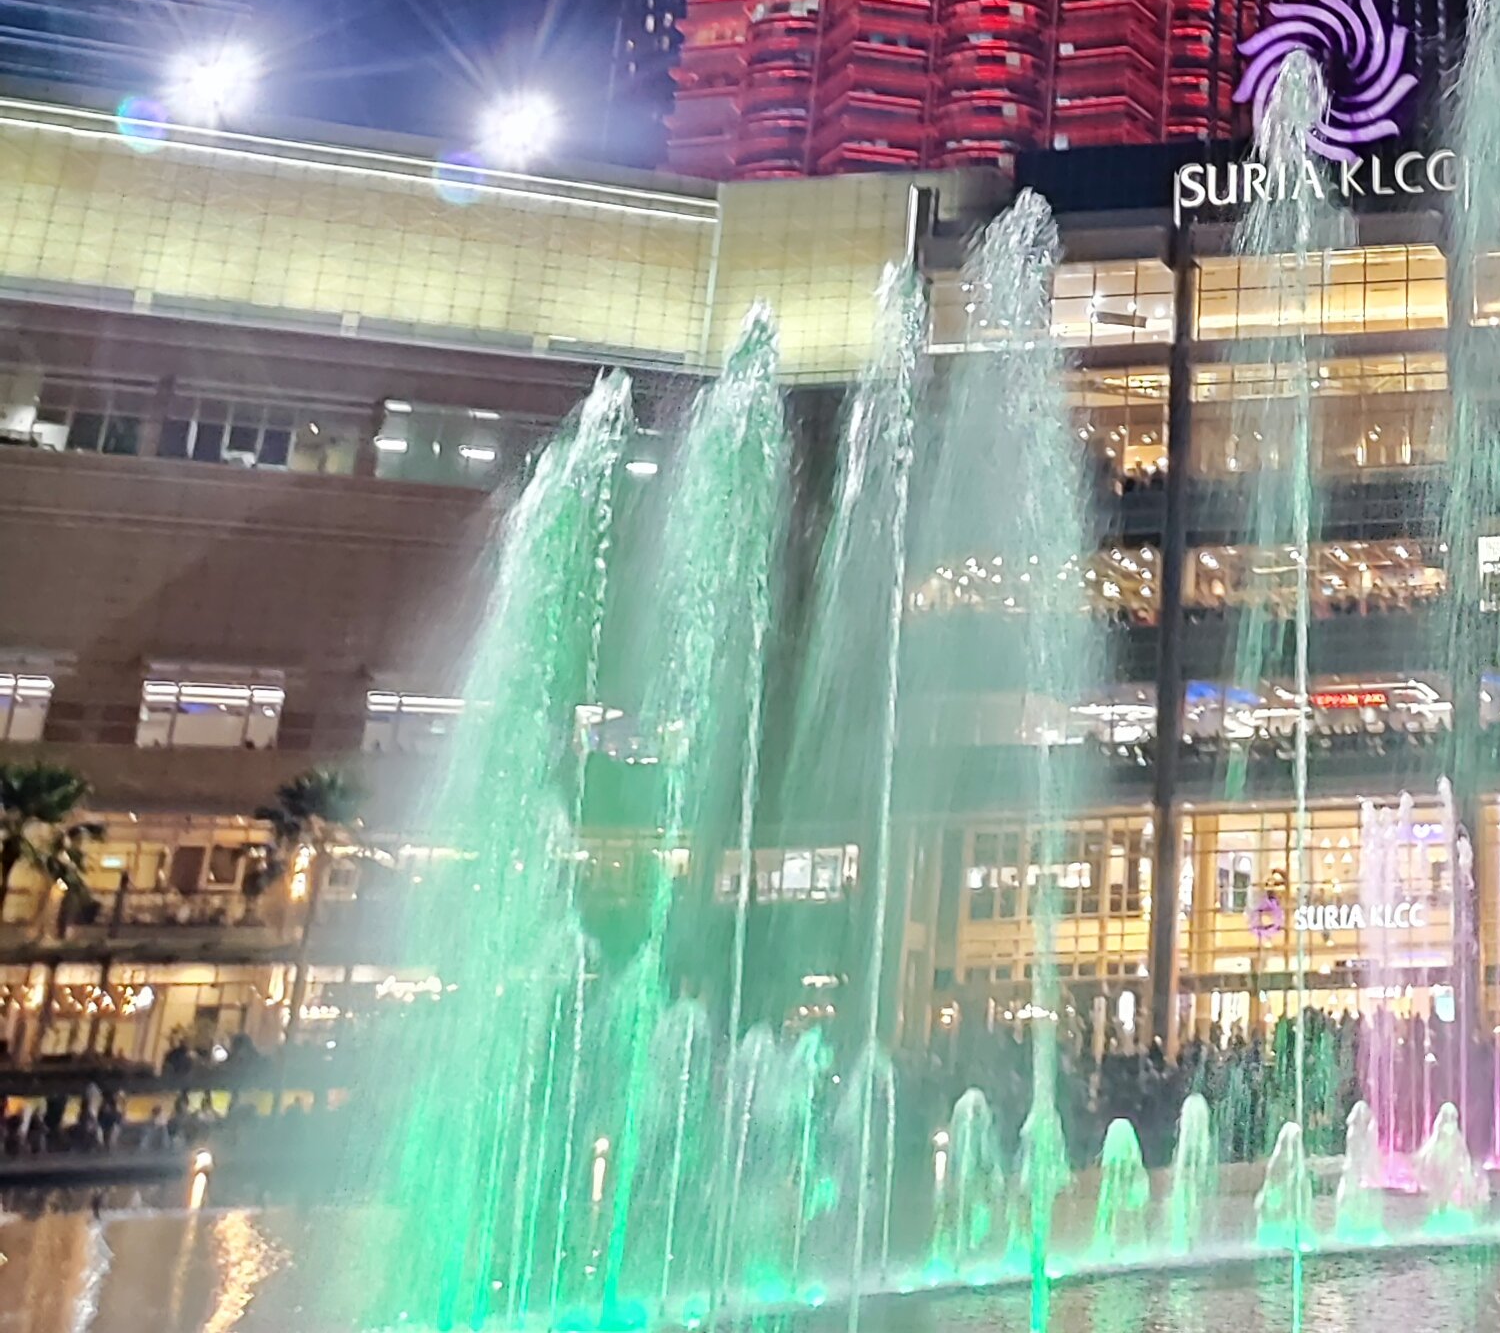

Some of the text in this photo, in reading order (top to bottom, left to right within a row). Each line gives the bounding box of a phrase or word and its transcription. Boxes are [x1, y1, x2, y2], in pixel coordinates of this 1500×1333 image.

[1179, 149, 1458, 209] SURIA KLCC
[1293, 903, 1426, 930] SURIA KLCC
